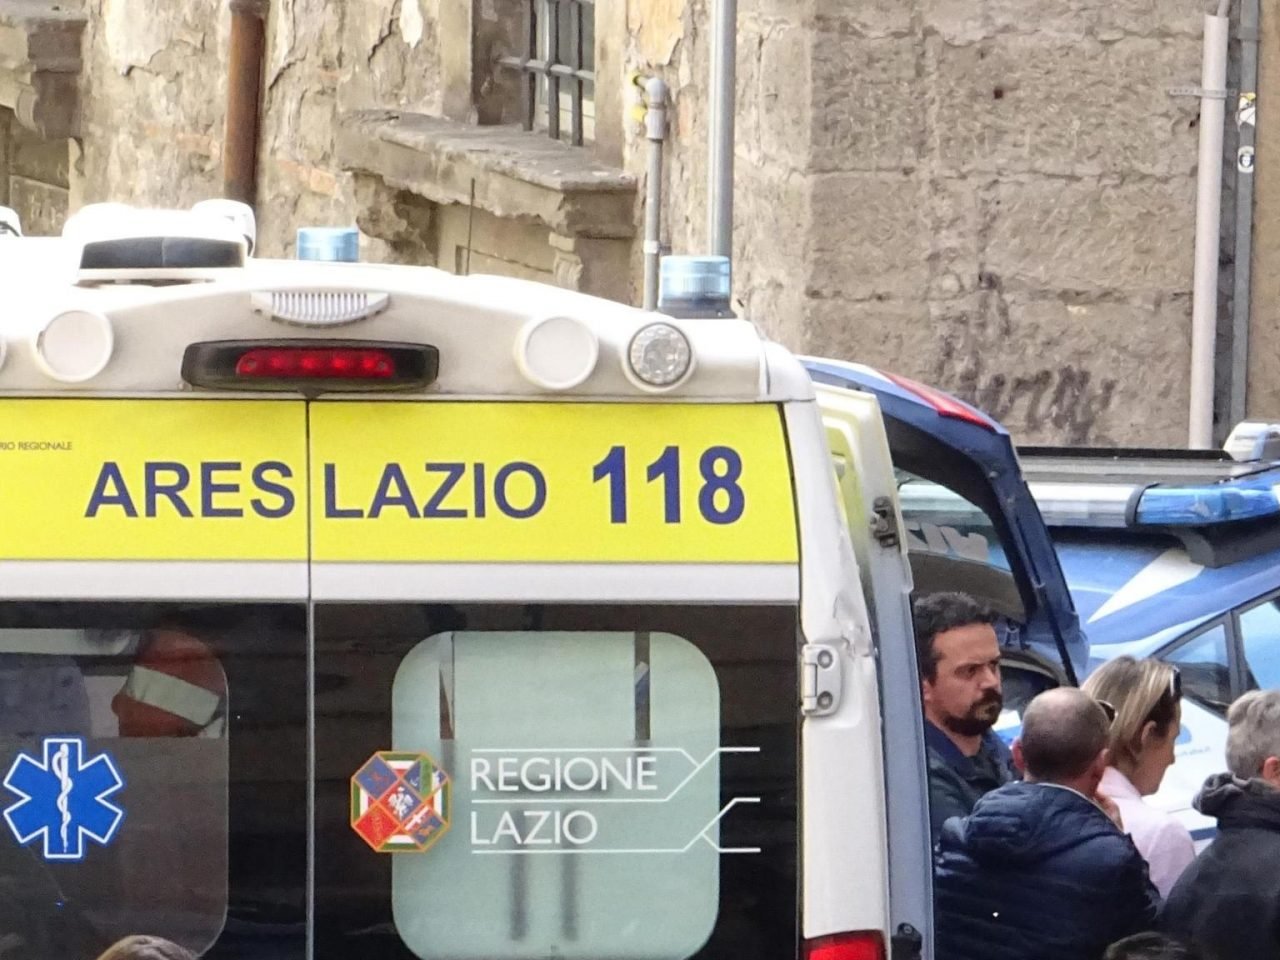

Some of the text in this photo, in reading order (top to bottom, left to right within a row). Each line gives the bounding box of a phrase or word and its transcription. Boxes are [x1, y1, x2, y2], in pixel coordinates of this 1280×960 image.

[18, 441, 73, 450] REGIONALE
[84, 445, 745, 524] ARES LAZIO 118
[471, 756, 657, 792] REGIONE
[471, 811, 598, 845] LAZIO
